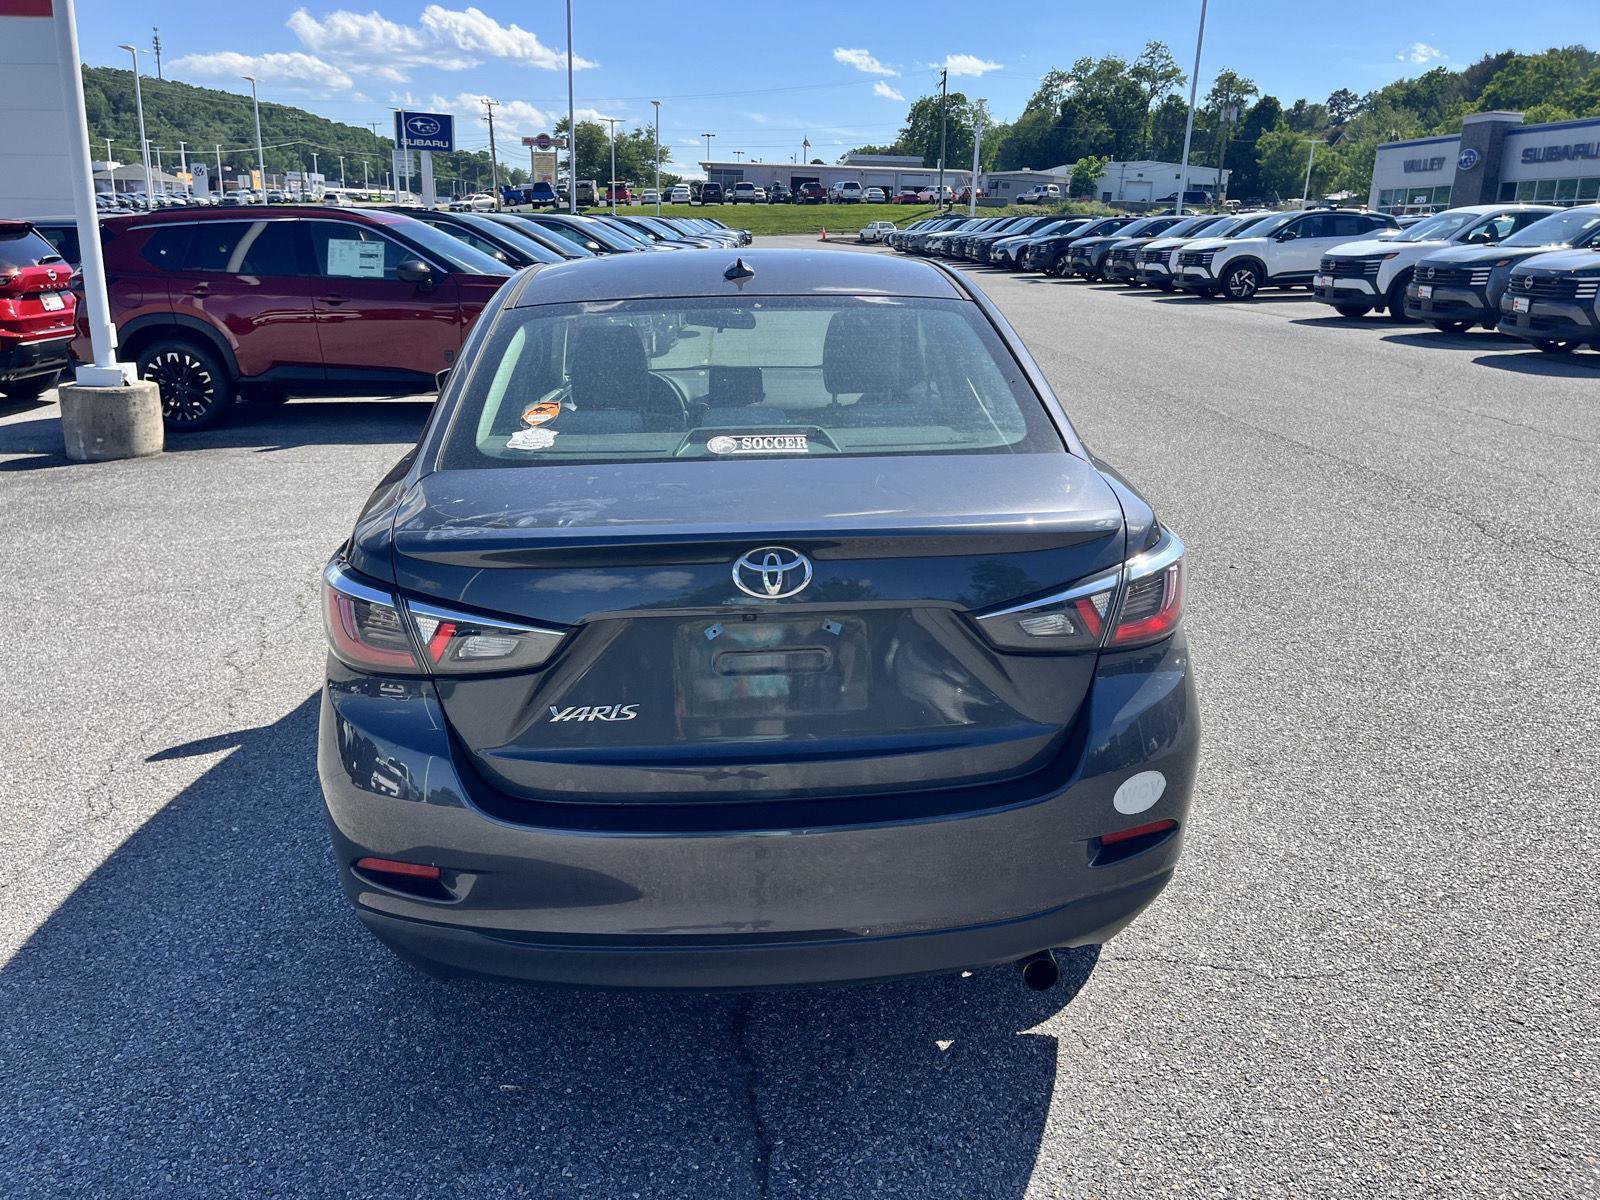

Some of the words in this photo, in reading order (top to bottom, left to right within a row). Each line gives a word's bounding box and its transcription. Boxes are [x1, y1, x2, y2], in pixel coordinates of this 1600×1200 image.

[401, 138, 449, 148] SUBARU
[1521, 142, 1600, 164] SUBARU
[1403, 157, 1446, 173] VALLEY
[741, 437, 808, 450] SOCCER
[549, 703, 640, 723] YARIS
